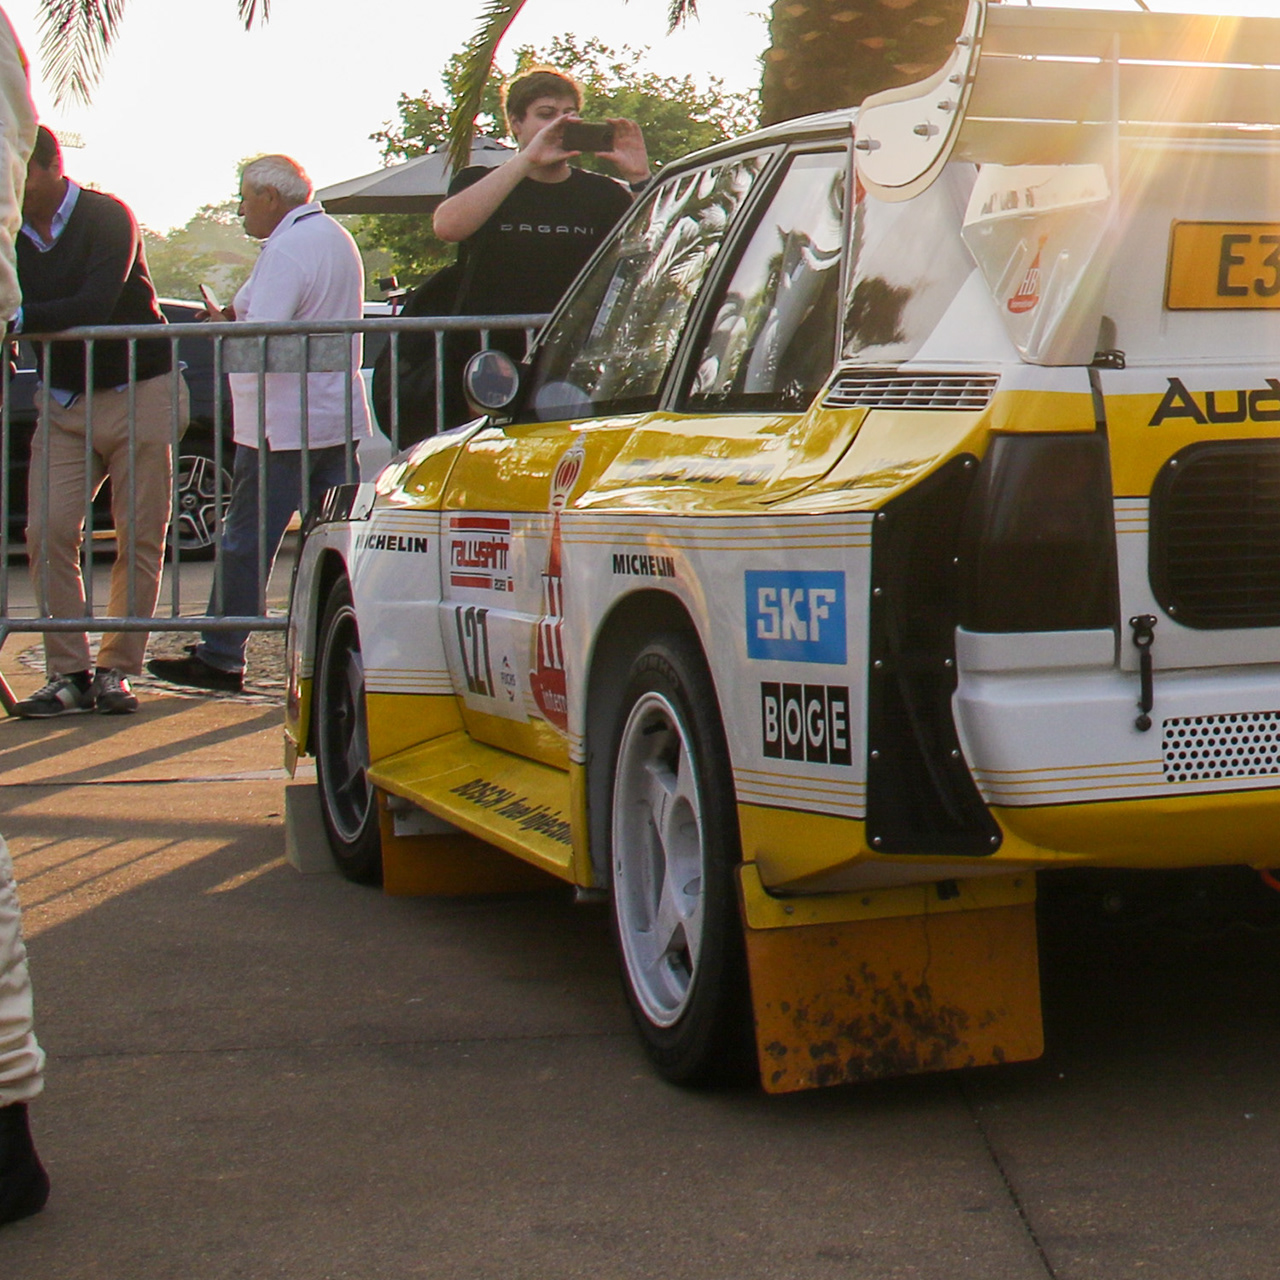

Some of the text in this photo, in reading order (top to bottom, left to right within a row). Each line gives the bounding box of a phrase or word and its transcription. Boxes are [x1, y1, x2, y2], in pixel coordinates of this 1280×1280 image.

[500, 223, 594, 235] PAGANI
[612, 553, 676, 578] MICHELIN
[756, 587, 837, 643] SKF
[764, 695, 847, 750] BOGE
